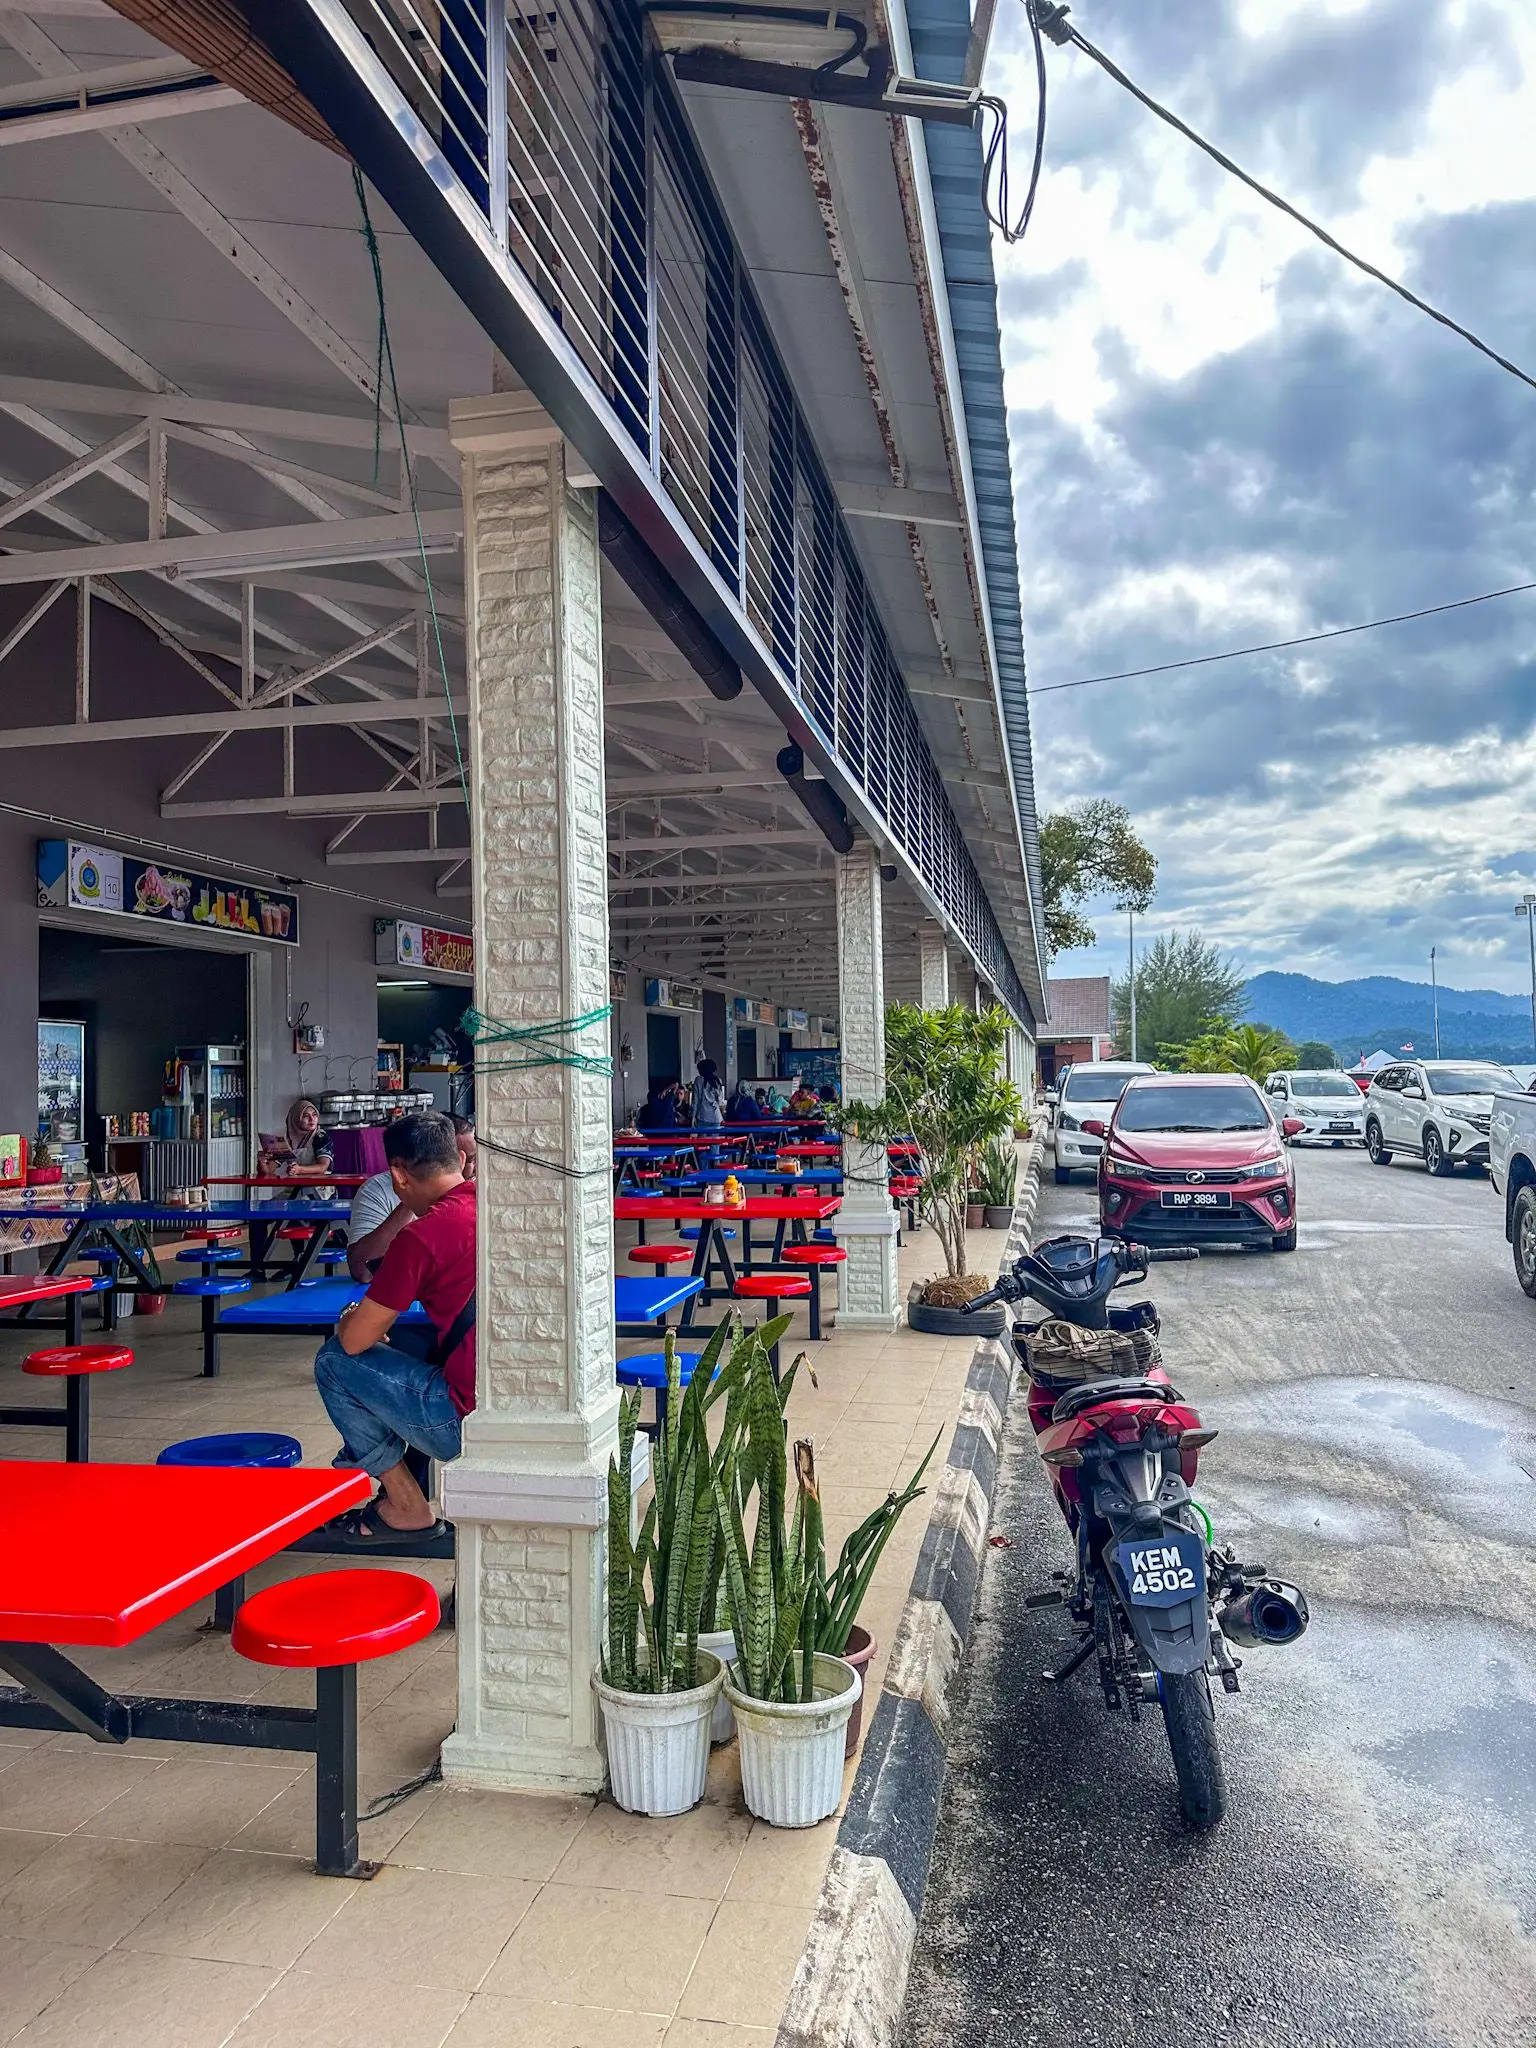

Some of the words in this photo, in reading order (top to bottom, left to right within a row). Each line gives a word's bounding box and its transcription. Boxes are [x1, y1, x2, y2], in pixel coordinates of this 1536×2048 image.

[107, 883, 118, 894] 10
[446, 941, 473, 961] CELUP
[1174, 1193, 1192, 1204] RAP
[1194, 1193, 1217, 1204] 3894
[1130, 1546, 1181, 1572] KEM
[1132, 1568, 1196, 1594] 4502
